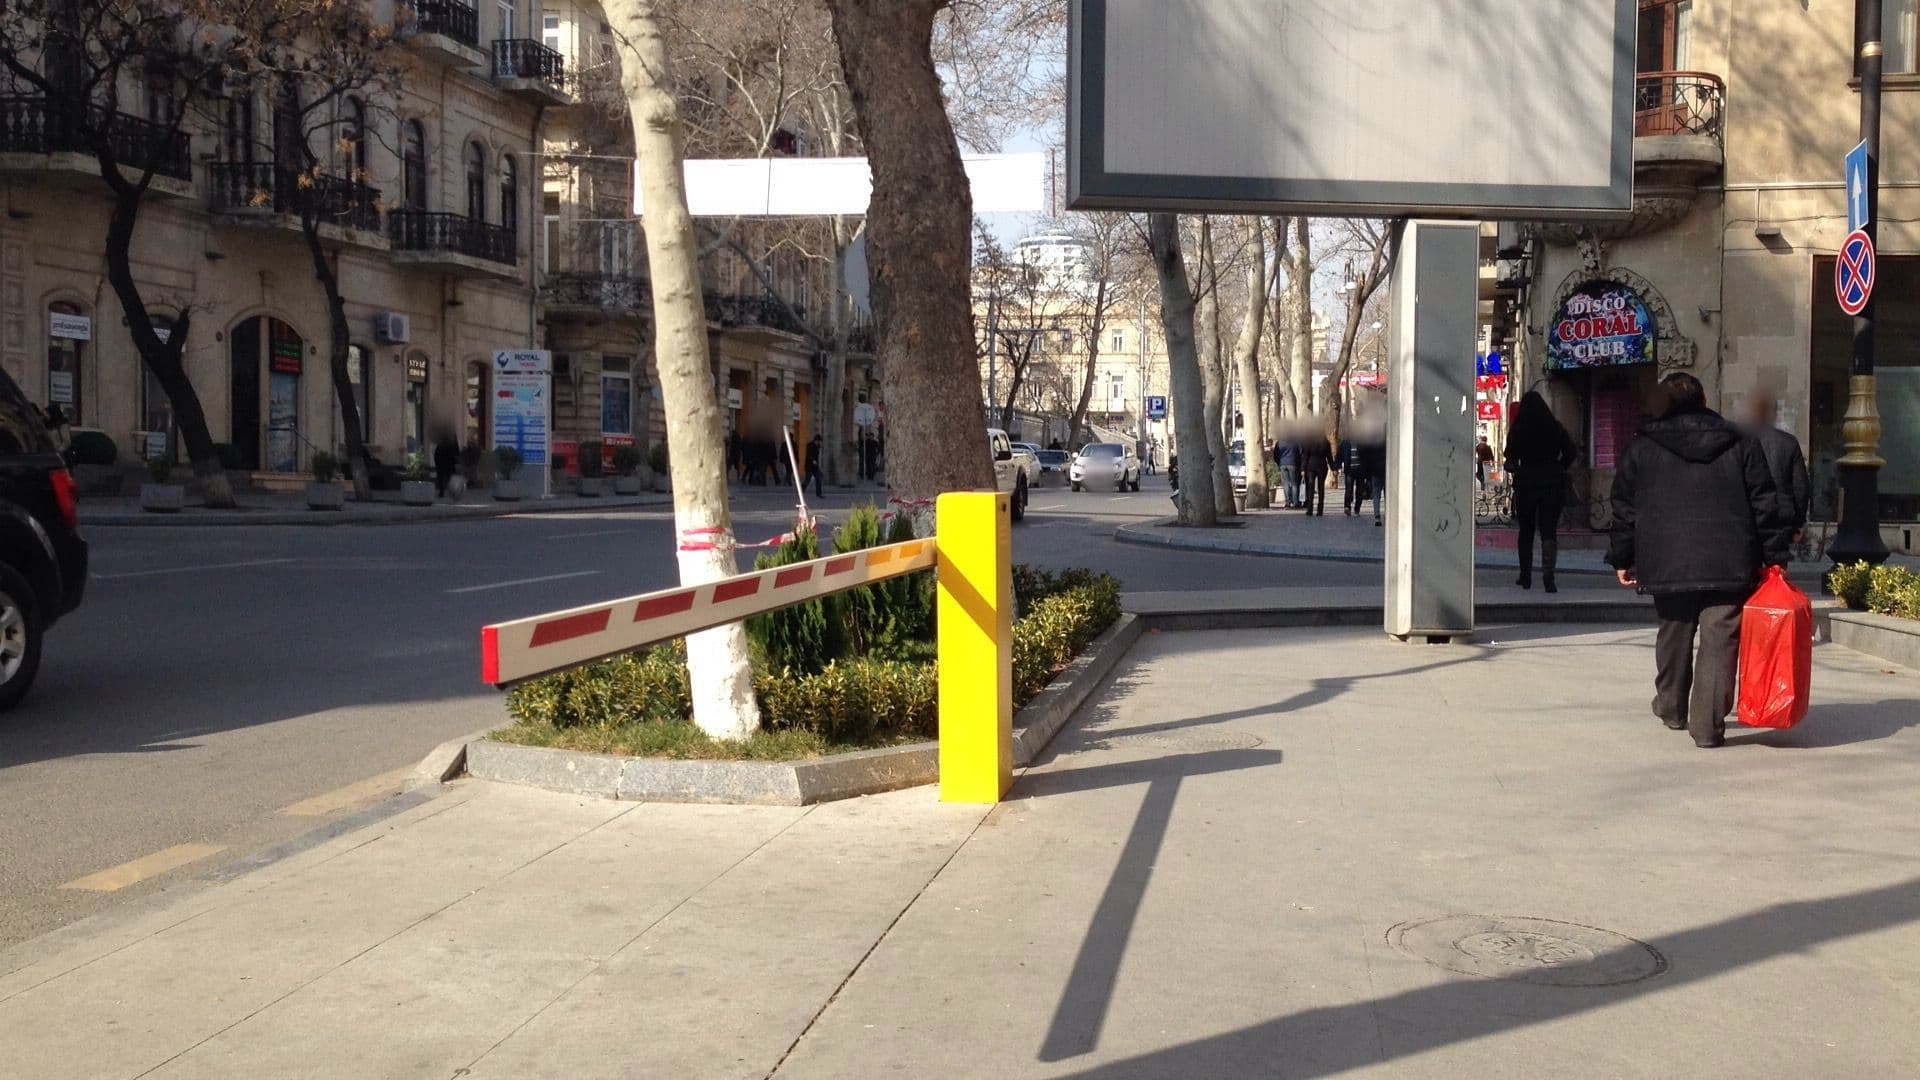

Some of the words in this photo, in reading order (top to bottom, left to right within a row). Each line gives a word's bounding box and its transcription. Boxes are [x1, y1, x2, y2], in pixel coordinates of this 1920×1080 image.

[1574, 297, 1625, 314] DISCO
[1558, 314, 1642, 341] CORAL
[514, 353, 540, 361] ROYAL
[1574, 341, 1624, 358] CLUB
[1151, 398, 1162, 410] P
